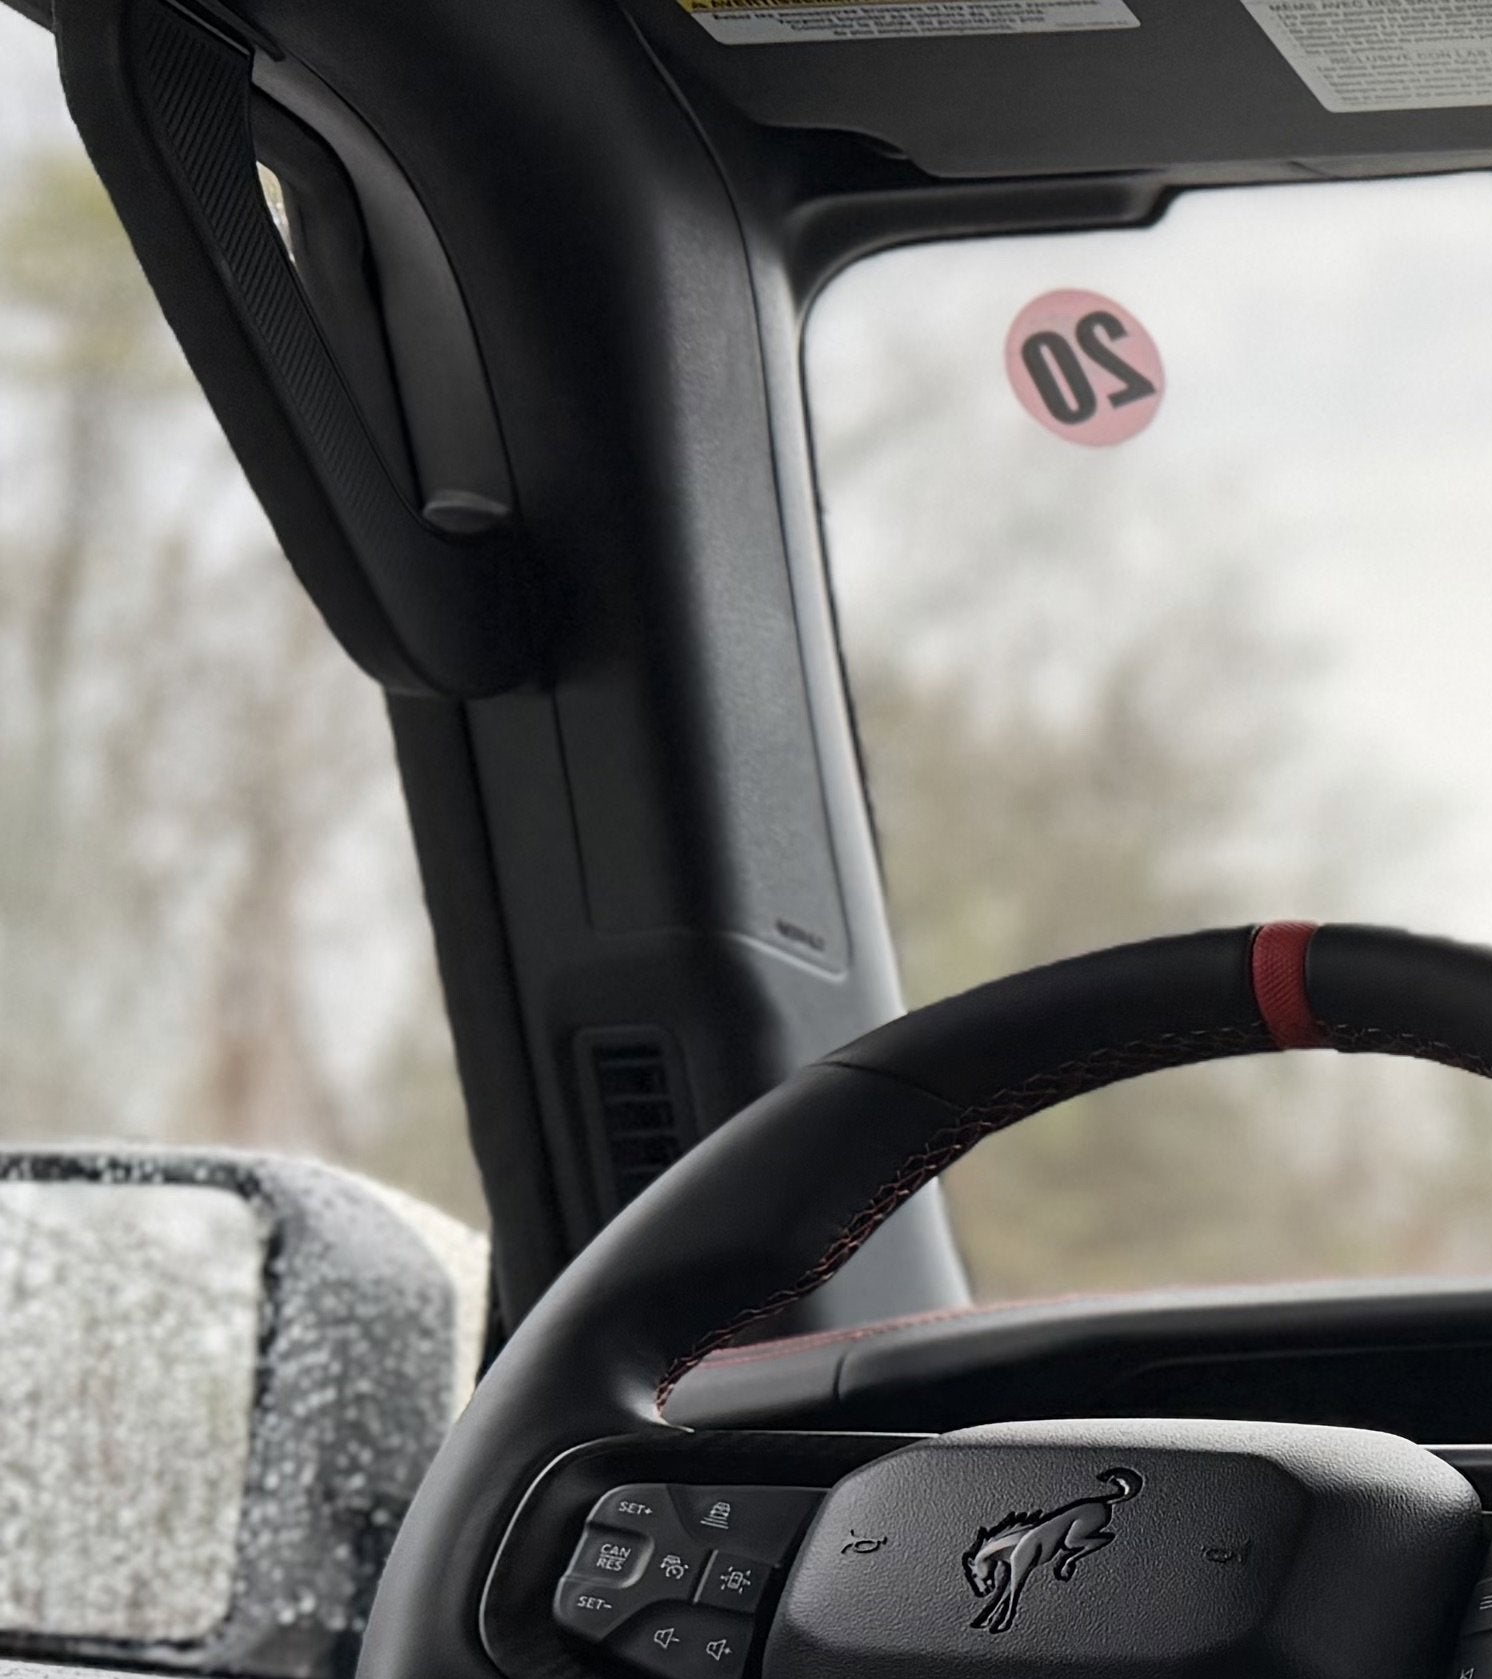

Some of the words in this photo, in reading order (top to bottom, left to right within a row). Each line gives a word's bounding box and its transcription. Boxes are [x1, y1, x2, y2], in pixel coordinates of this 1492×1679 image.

[618, 1500, 654, 1516] SET+
[600, 1542, 632, 1559] CAN
[596, 1556, 624, 1572] RES
